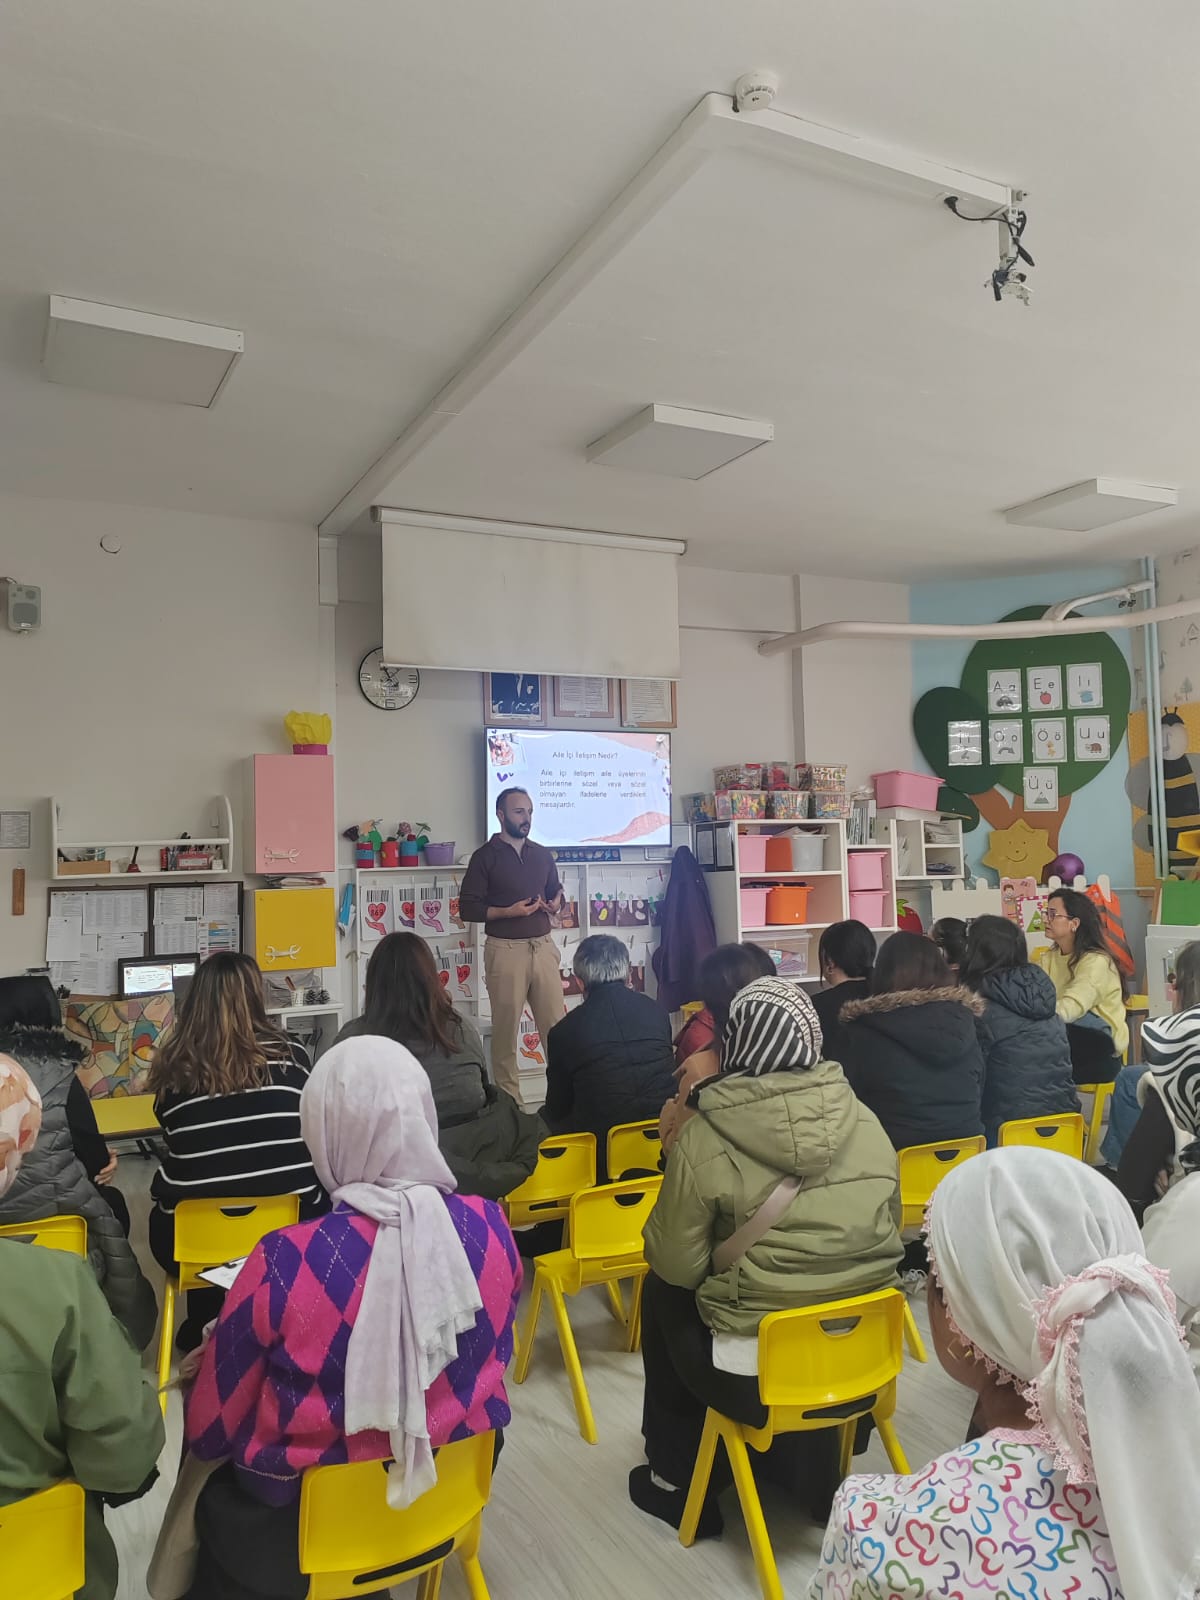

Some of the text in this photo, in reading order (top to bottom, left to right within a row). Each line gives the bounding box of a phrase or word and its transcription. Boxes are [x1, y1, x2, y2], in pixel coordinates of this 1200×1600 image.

[993, 680, 1016, 692] A a
[1033, 677, 1055, 690] E e
[993, 730, 1018, 743] O o
[1037, 727, 1062, 742] Ö ö
[1079, 727, 1105, 740] U u
[1028, 775, 1053, 790] Ü ü
